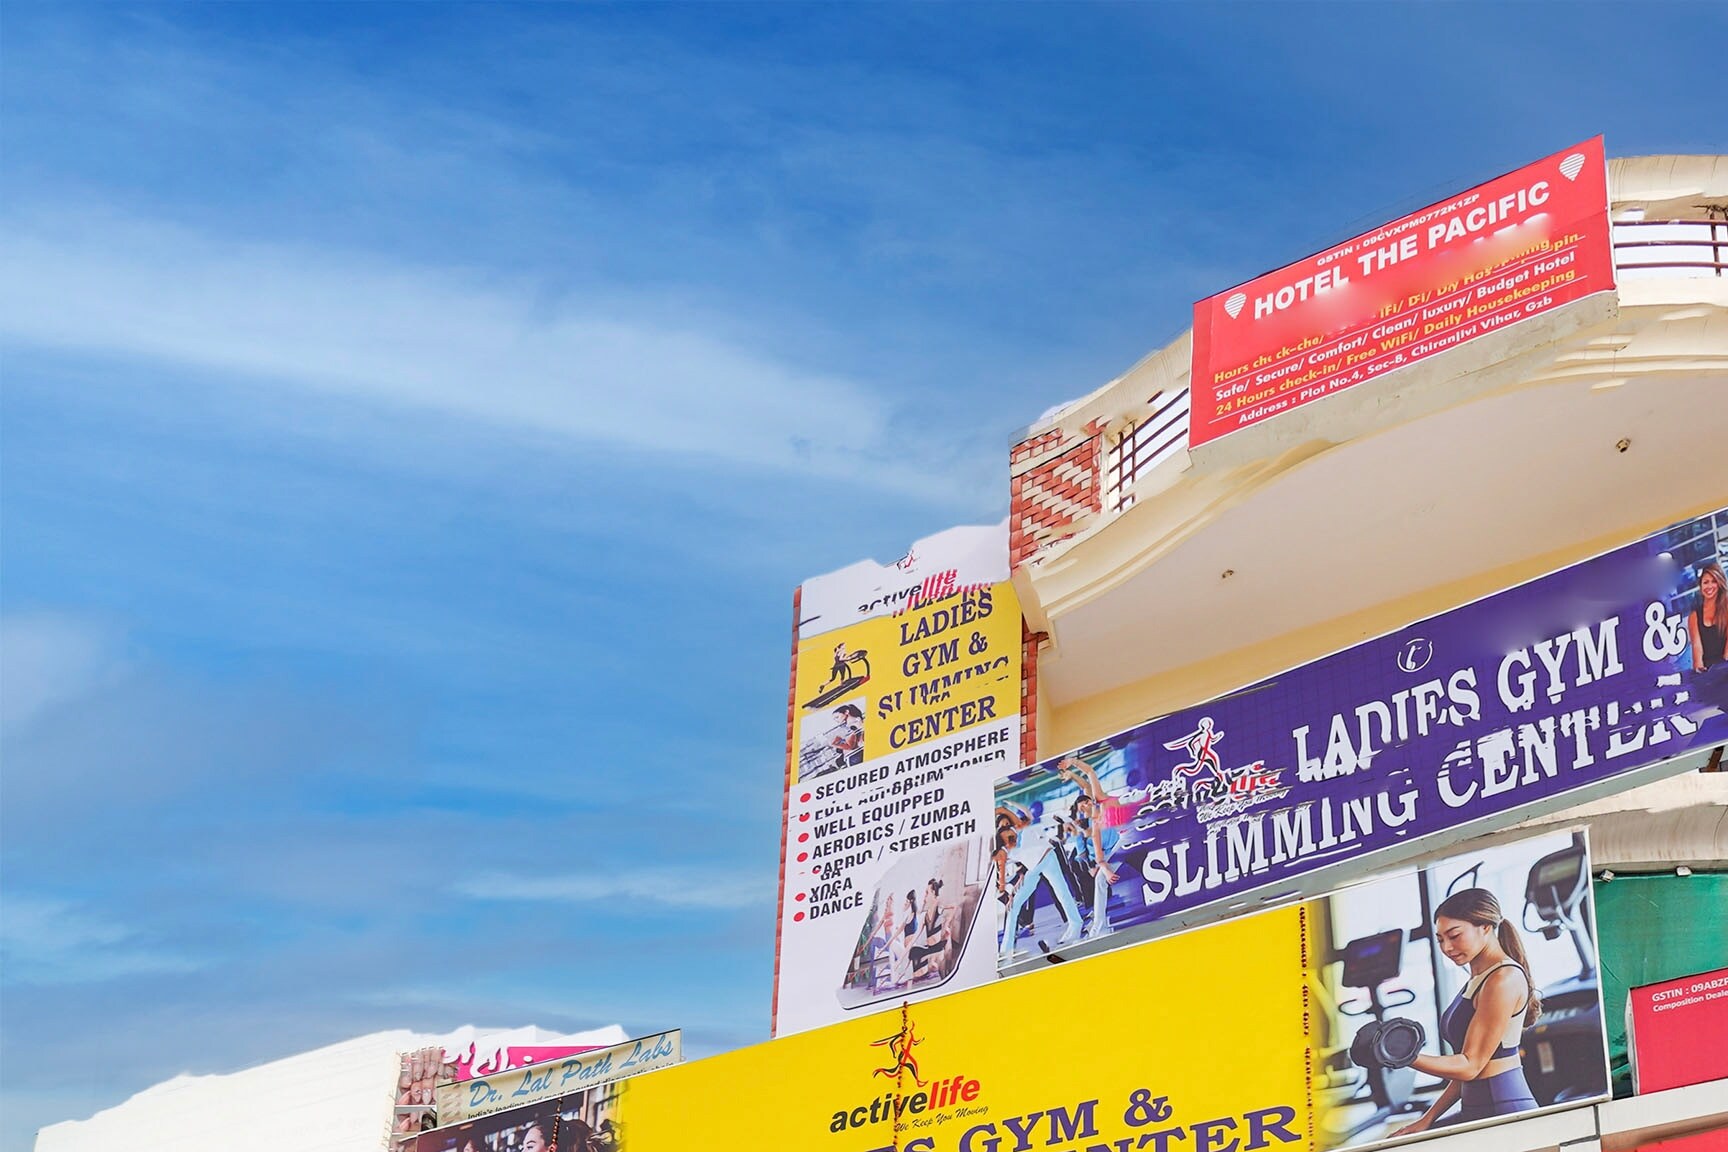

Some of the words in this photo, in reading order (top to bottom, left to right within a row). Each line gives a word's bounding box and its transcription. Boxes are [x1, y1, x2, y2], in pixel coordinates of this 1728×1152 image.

[1254, 265, 1349, 320] HOTEL
[1358, 234, 1418, 277] THE
[1428, 181, 1550, 250] PACIFIC
[1215, 379, 1250, 401] Safe/
[1255, 357, 1304, 386] Secure/
[1308, 333, 1368, 365] Comfort/
[1372, 314, 1418, 340] Clean/
[1476, 270, 1530, 298] Budget
[1534, 251, 1574, 276] Hotel
[1216, 402, 1232, 416] 24
[1236, 386, 1275, 408] Hours
[1279, 358, 1342, 396] check-in/
[1346, 346, 1377, 366] Free
[1380, 328, 1420, 352] WiFi/
[1424, 311, 1463, 336] Daily
[1466, 270, 1576, 318] Housekeeping
[1239, 400, 1288, 424] Address
[1300, 384, 1327, 401] Plot
[1411, 327, 1477, 358] Chiranjivi
[1525, 296, 1552, 312] Gzb
[902, 638, 960, 678] GYM
[968, 631, 987, 657] &
[1292, 667, 1483, 782] LADIES
[1496, 616, 1626, 714] GYM
[1642, 601, 1687, 662] &
[888, 695, 997, 749] CENTER
[815, 766, 889, 800] SECURED
[895, 728, 1010, 775] ATMOSPHERE
[812, 823, 894, 860] AEROBICS
[910, 800, 971, 830] ZUMBA
[813, 815, 856, 839] WELL
[862, 788, 945, 826] EQUIPPED
[1141, 781, 1421, 906] SLIMMING
[810, 891, 864, 920] DANCE
[1652, 987, 1683, 1002] GSTIN
[1653, 995, 1704, 1012] Composition
[470, 1081, 502, 1107] Dr.
[512, 1068, 553, 1097] Lal
[561, 1052, 613, 1087] Path
[619, 1034, 674, 1069] Labs
[829, 1075, 981, 1133] activelife
[1122, 1087, 1174, 1129] &
